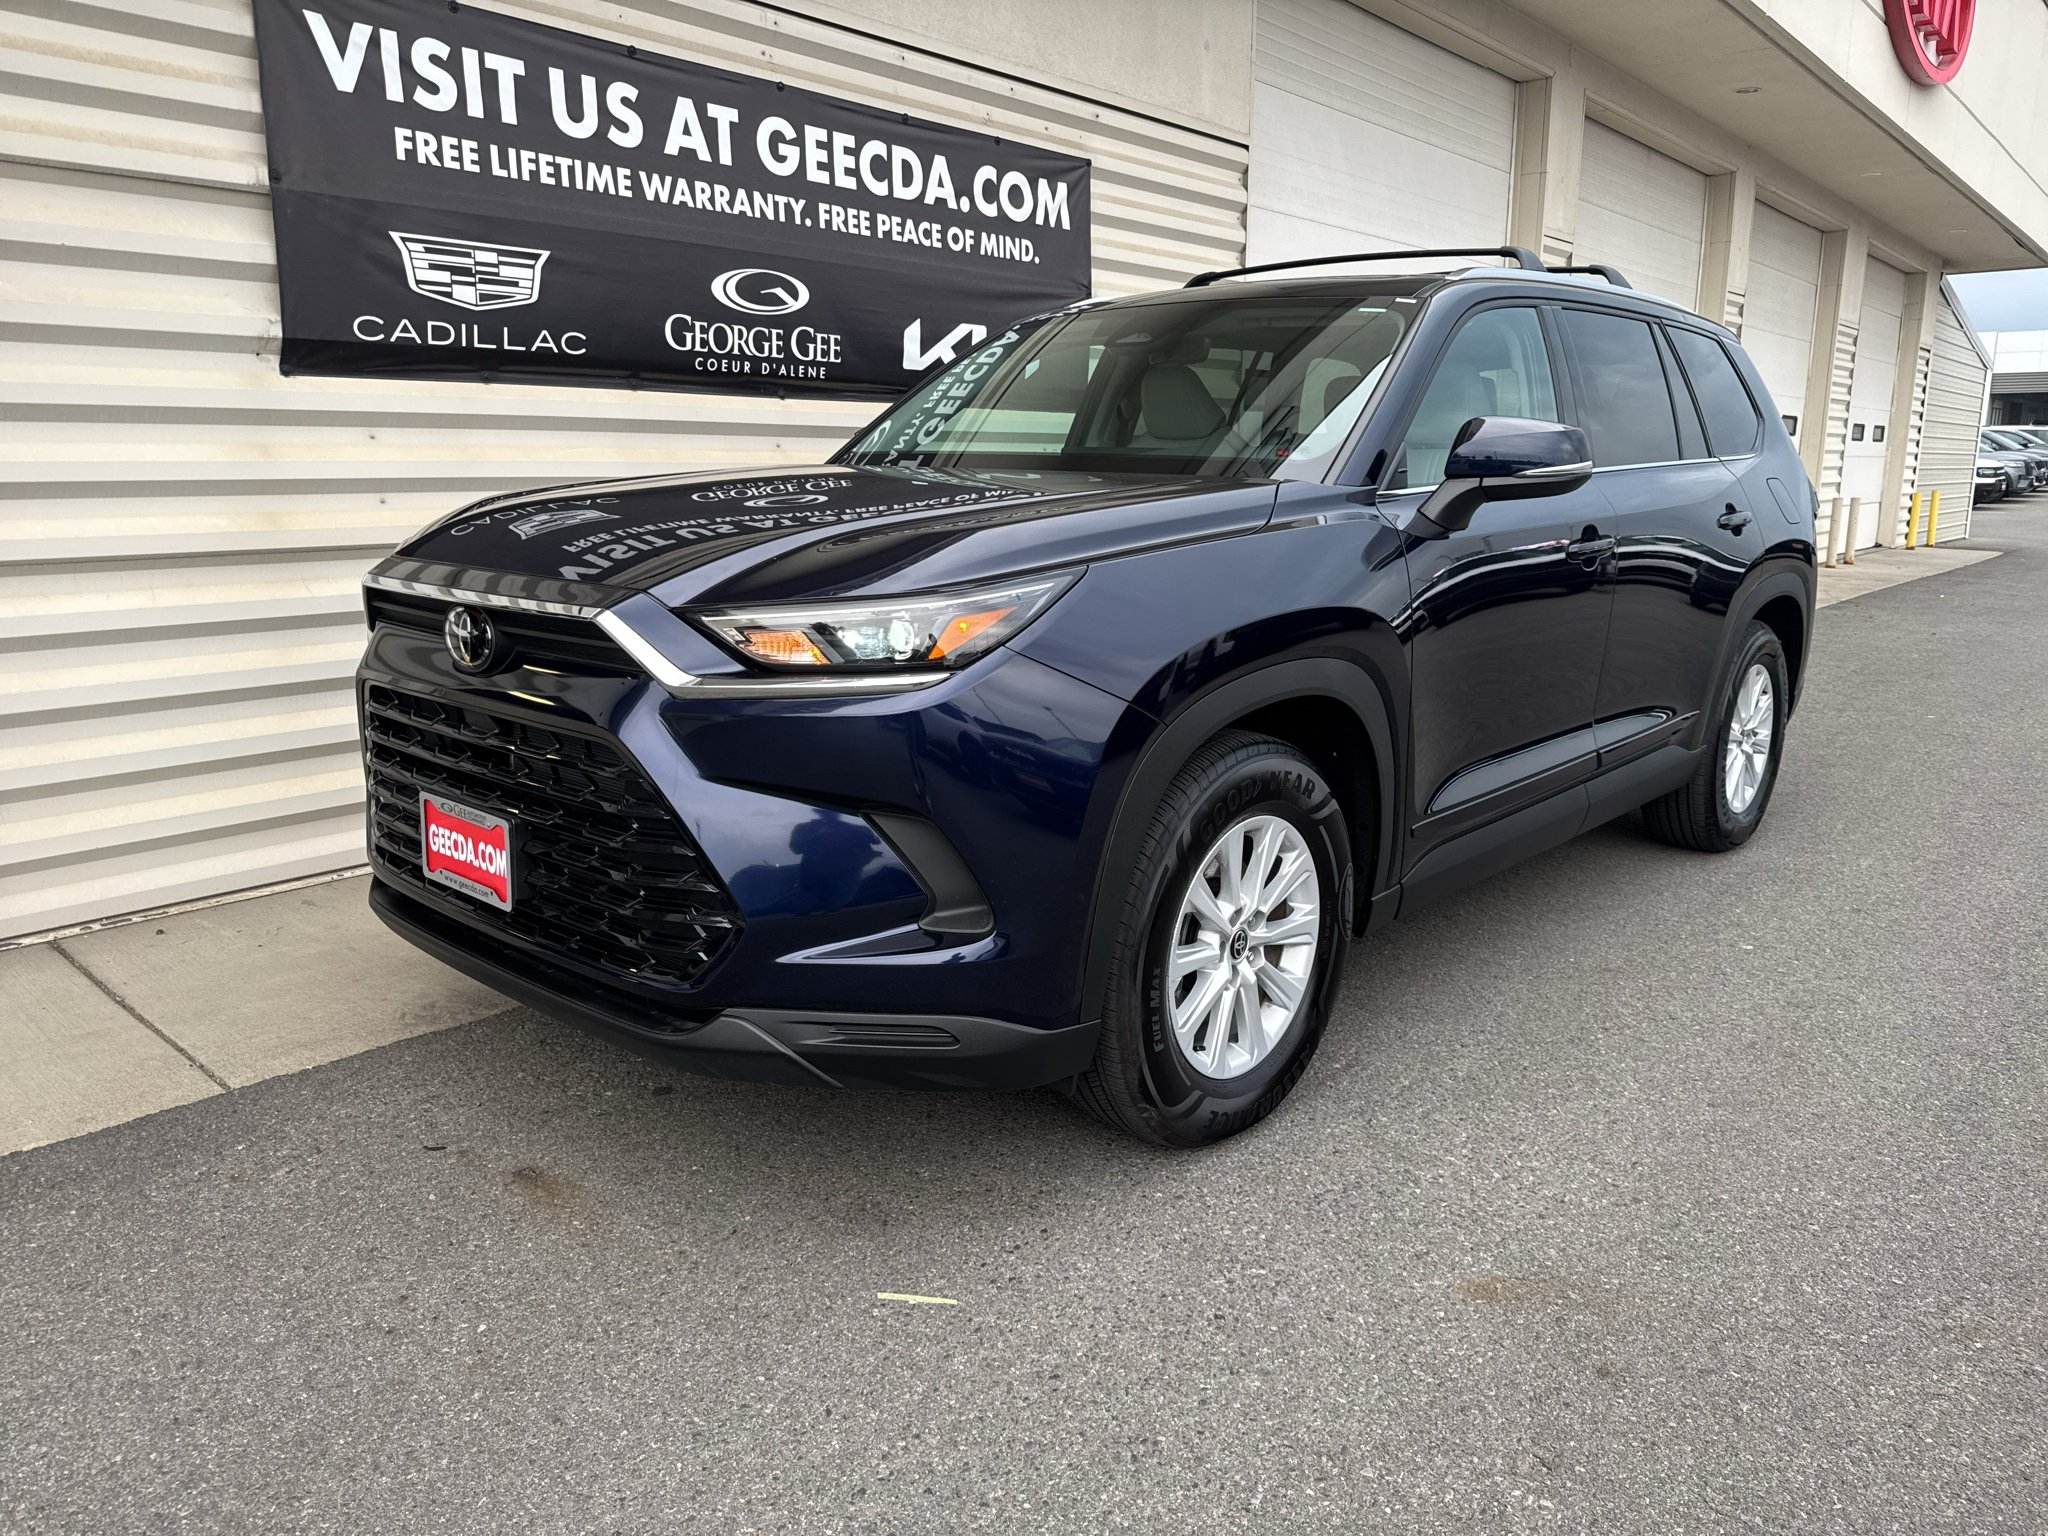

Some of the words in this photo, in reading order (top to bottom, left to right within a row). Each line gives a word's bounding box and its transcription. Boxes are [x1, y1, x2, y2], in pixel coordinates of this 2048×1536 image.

[302, 9, 525, 125] VISIT
[548, 66, 644, 148] US
[663, 96, 739, 167] AT
[756, 116, 1071, 230] GEECDA.COM
[394, 126, 481, 173] FREE
[490, 144, 632, 198] LIFETIME
[639, 171, 812, 228] WARRANTY.
[818, 203, 871, 236] FREE
[877, 213, 942, 249] PEACE
[947, 226, 975, 253] OF
[980, 233, 1040, 264] MIND.
[352, 315, 587, 355] CADILLAC
[664, 313, 785, 359] GEORGE
[790, 325, 842, 364] GEE
[694, 357, 751, 374] COEUR
[761, 363, 826, 380] D'ALENE
[429, 823, 507, 878] GEECDA.COM
[444, 875, 489, 898] www.geecda.com
